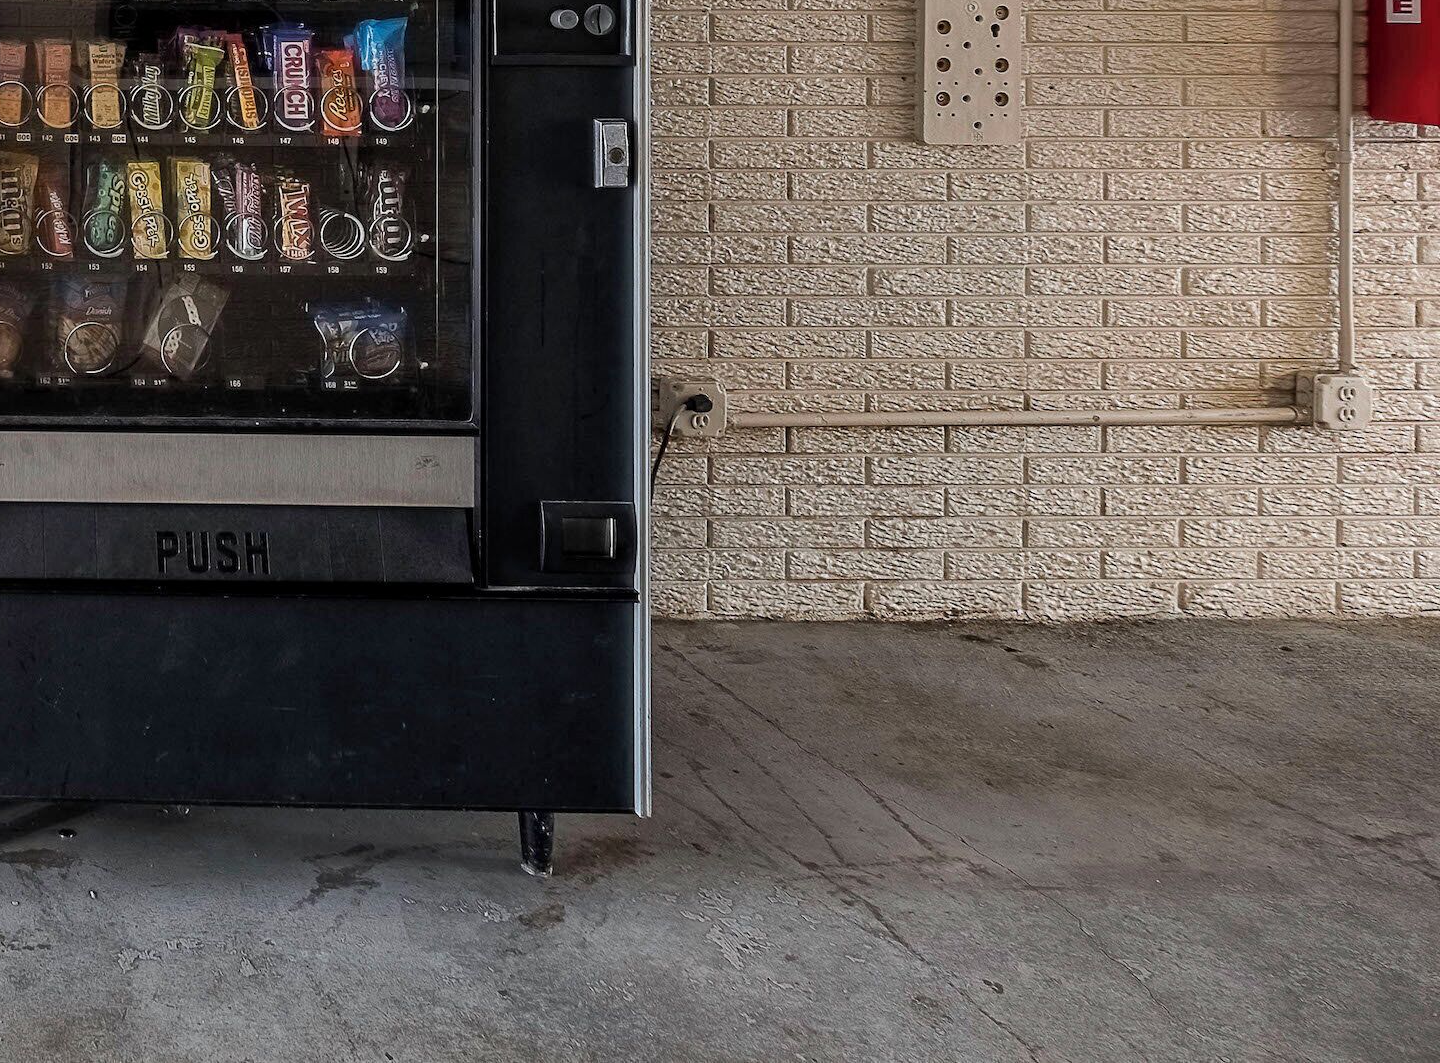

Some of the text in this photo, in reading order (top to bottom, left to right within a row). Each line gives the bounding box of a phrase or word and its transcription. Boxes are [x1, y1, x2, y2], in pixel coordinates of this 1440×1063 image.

[143, 65, 162, 126] Milky Way
[283, 43, 307, 118] CRUNCH
[0, 168, 24, 247] m&m's
[109, 173, 125, 243] Spree
[156, 531, 271, 575] PUSH
